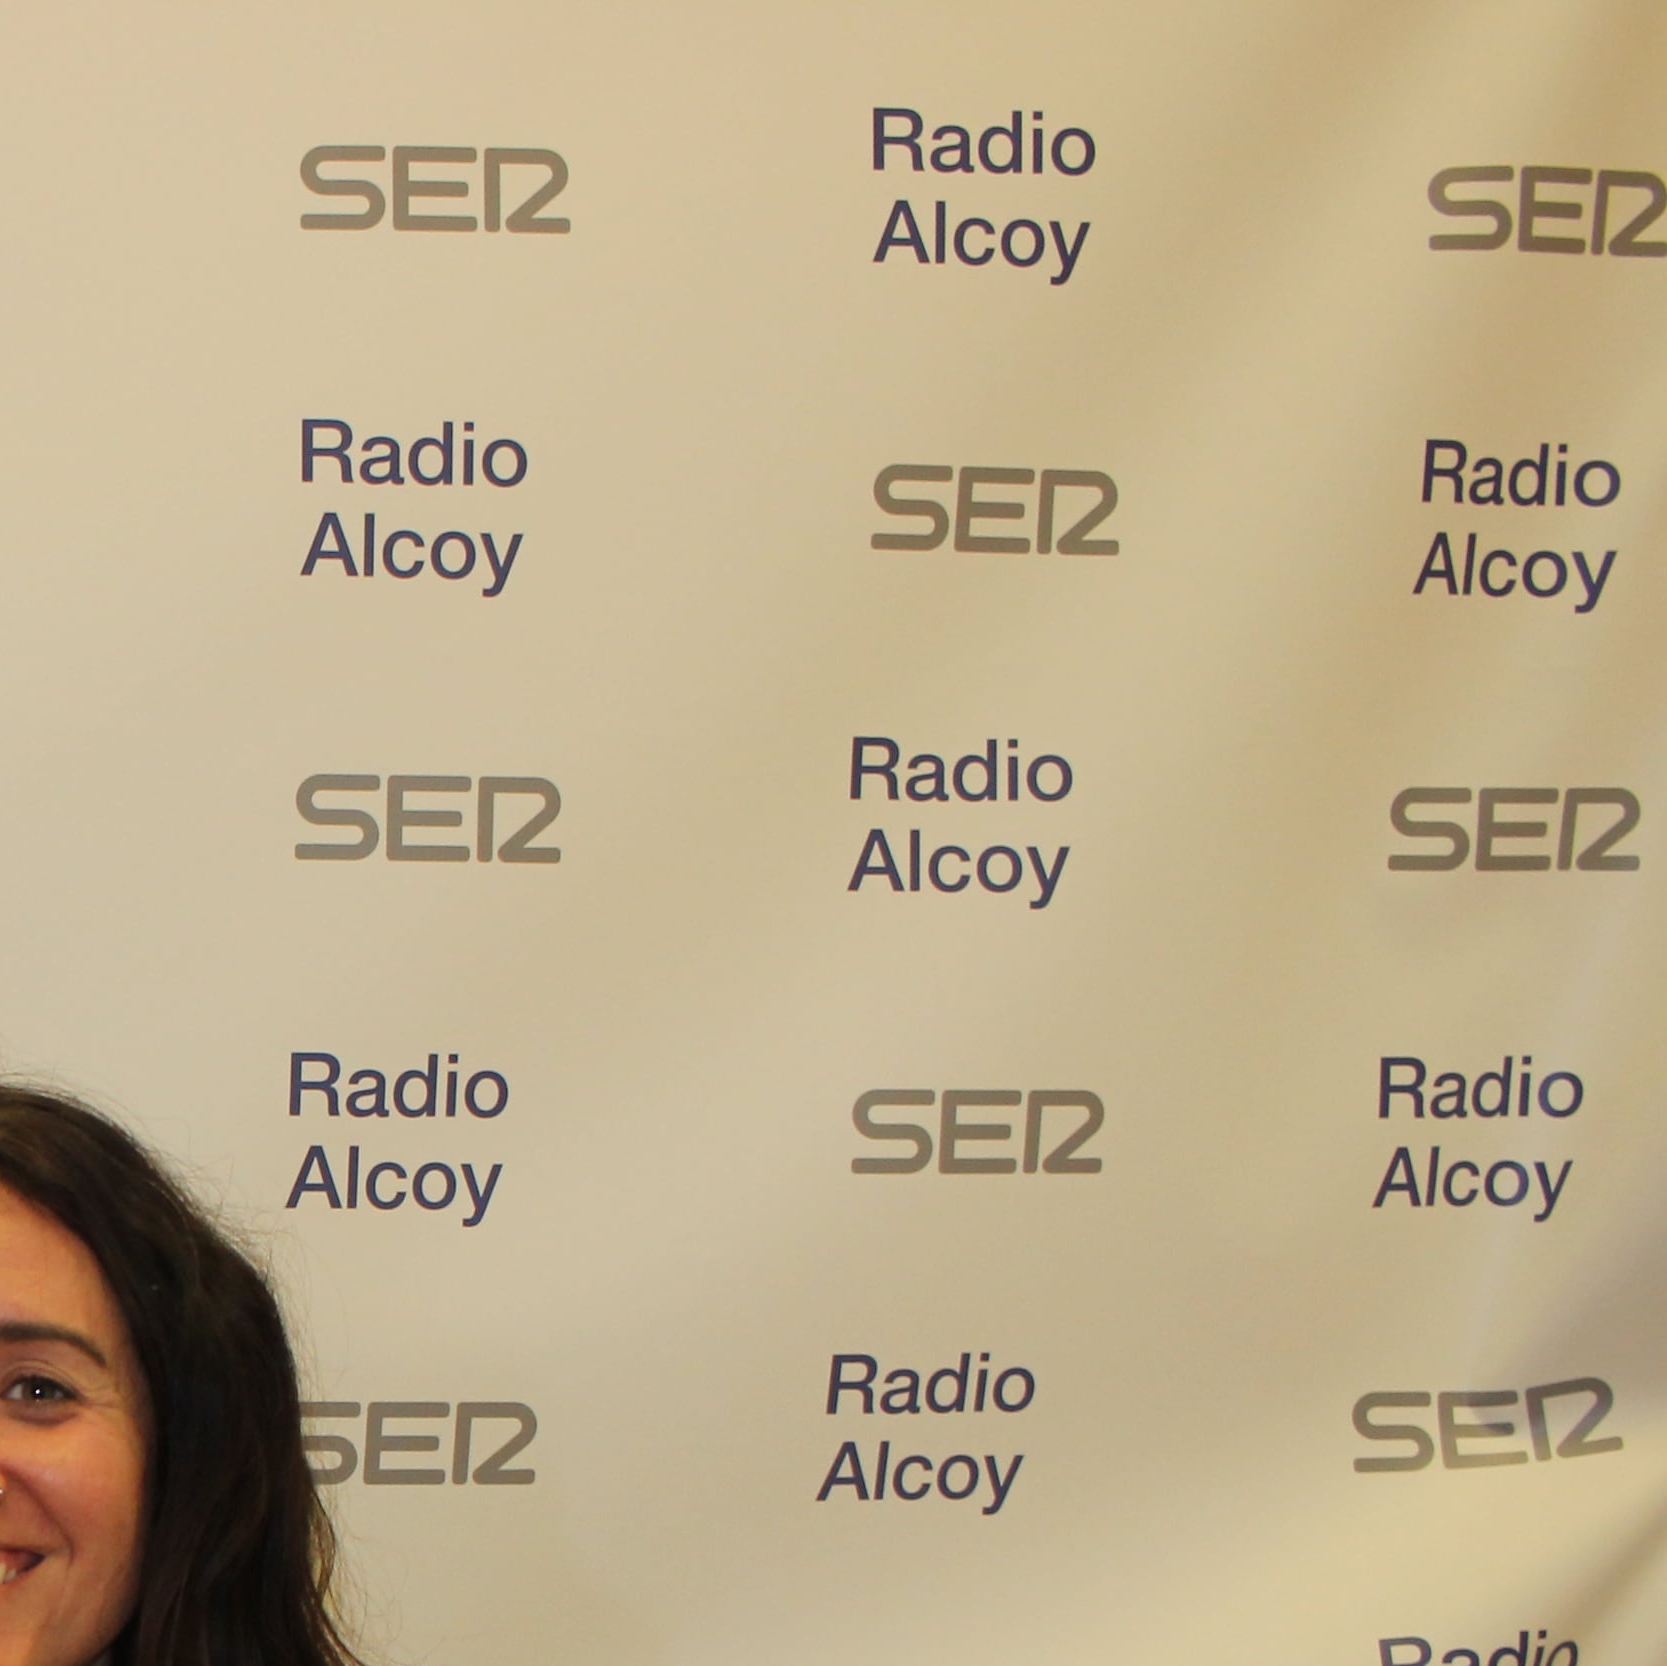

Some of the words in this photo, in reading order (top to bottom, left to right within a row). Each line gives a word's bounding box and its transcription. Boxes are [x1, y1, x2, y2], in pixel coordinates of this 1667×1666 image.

[873, 107, 1096, 176] Radio
[300, 145, 571, 234] SER
[1428, 165, 1667, 257] SER
[873, 199, 1091, 286] Alcoy
[301, 418, 528, 488] Radio
[1421, 439, 1621, 507] Radio
[871, 464, 1119, 556] SER
[300, 512, 524, 598] Alcoy
[1412, 531, 1617, 614] Alcoy
[850, 736, 1073, 802] Radio
[295, 774, 561, 863] SER
[1388, 787, 1641, 872] SER
[847, 828, 1070, 910] Alcoy
[289, 1052, 509, 1119] Radio
[1378, 1055, 1584, 1119] Radio
[851, 1089, 1104, 1174] SER
[285, 1145, 503, 1228] Alcoy
[1372, 1145, 1573, 1223] Alcoy
[826, 1352, 1036, 1415] Radio
[1352, 1377, 1623, 1473] SER
[816, 1440, 1024, 1516] Alcoy
